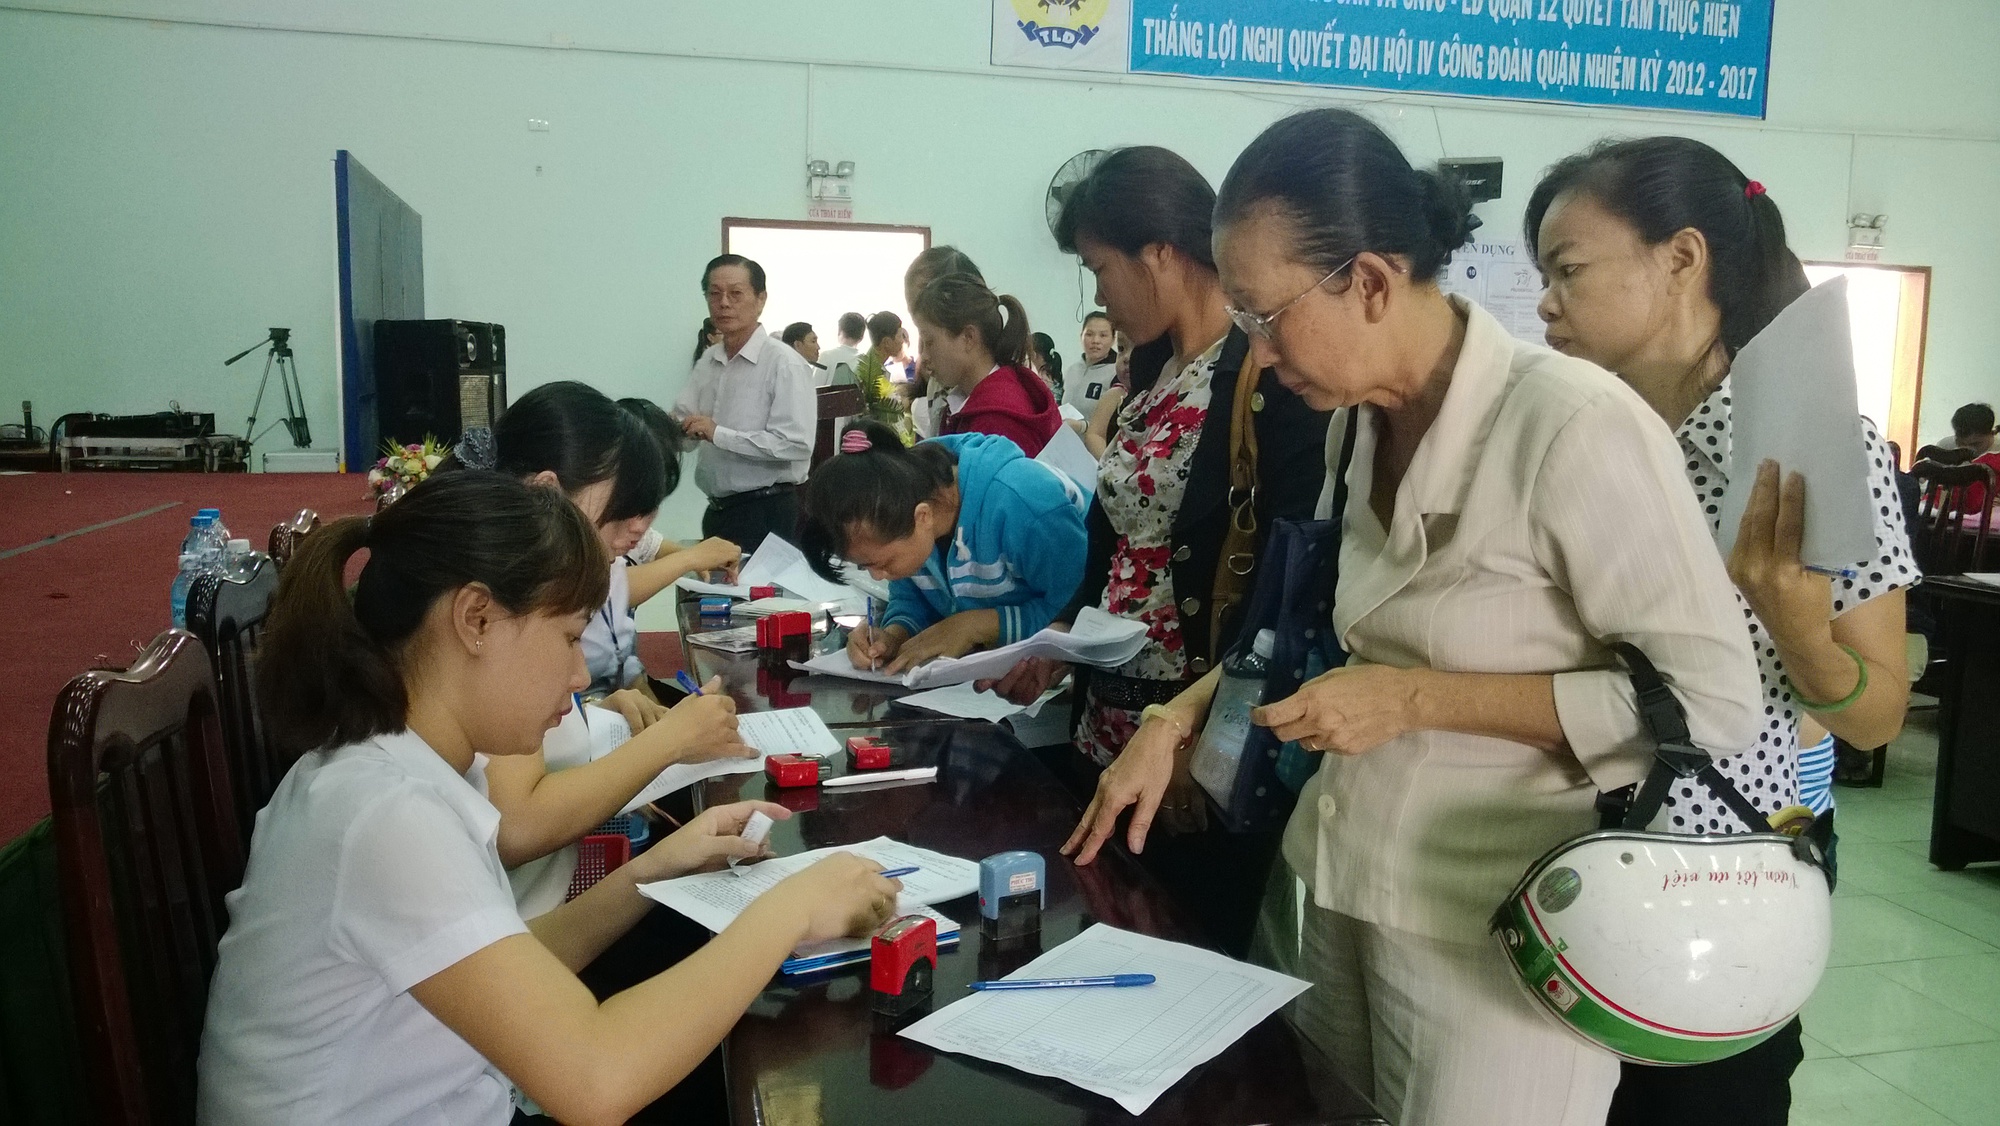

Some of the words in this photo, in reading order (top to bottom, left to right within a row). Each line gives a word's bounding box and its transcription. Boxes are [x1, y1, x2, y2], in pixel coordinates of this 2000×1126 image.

[1537, 0, 1557, 21] 12
[1658, 0, 1699, 41] THỰC
[1702, 0, 1741, 44] HIỆN
[1142, 4, 1203, 58] THẮNG
[1207, 19, 1237, 68] LỢI
[1242, 26, 1284, 72] NGHỊ
[1288, 19, 1345, 72] QUYẾT
[1348, 35, 1379, 78] ĐẠI
[1382, 29, 1413, 81] HỘI
[1417, 40, 1435, 75] IV
[1438, 33, 1483, 80] CÔNG
[1487, 38, 1532, 82] ĐOÀN
[1536, 41, 1581, 92] QUẬN
[1584, 46, 1636, 96] NHIỆM
[1640, 50, 1662, 92] KỲ
[1665, 60, 1705, 96] 2012
[1718, 65, 1758, 100] 2017
[1481, 244, 1515, 258] DỤNG
[1468, 269, 1476, 277] 10
[1662, 869, 1699, 892] việt
[1736, 870, 1758, 888] tới
